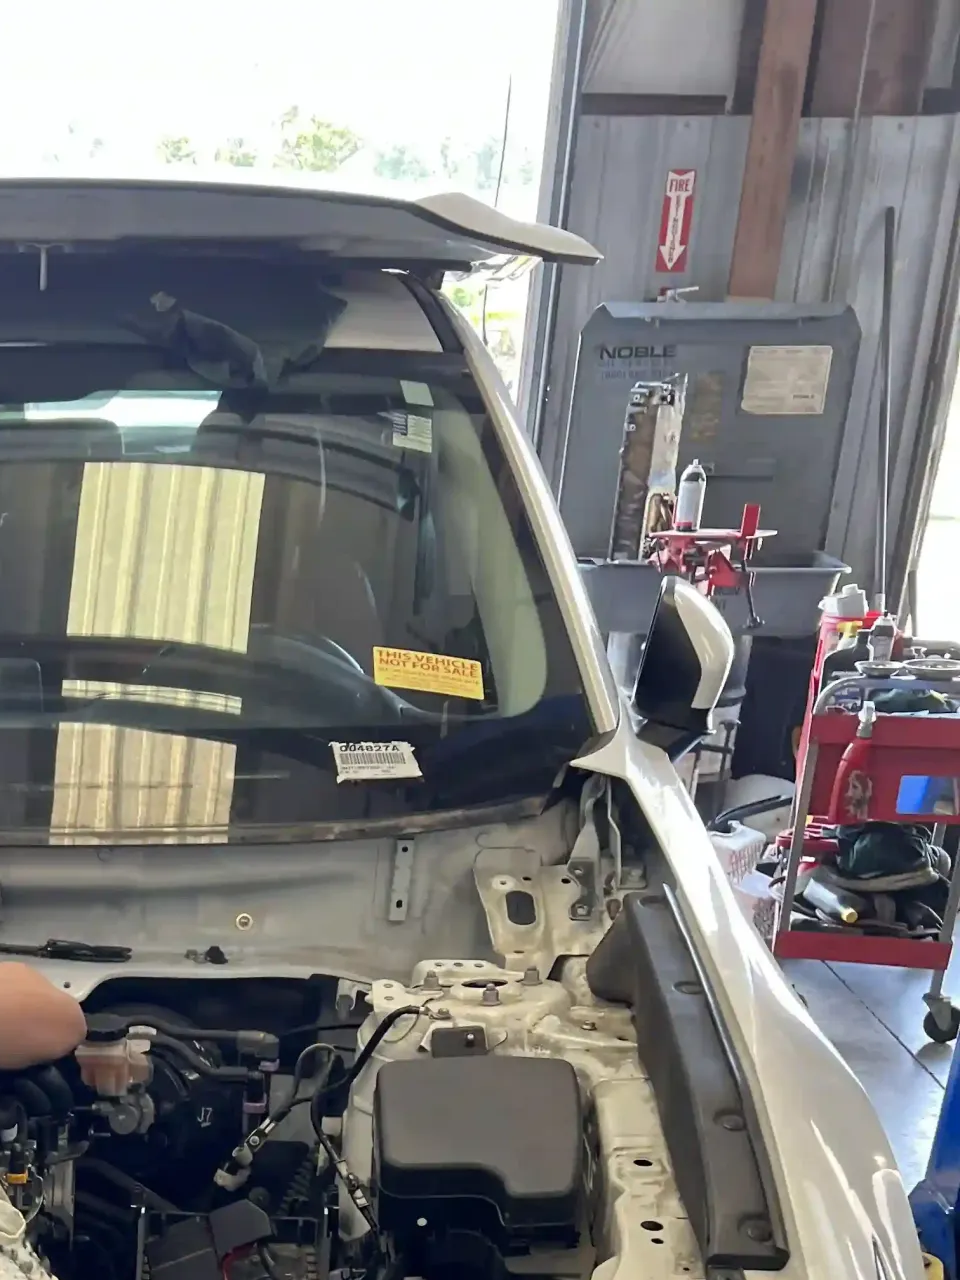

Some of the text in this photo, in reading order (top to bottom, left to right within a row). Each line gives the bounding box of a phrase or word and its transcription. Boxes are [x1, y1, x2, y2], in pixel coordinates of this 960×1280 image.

[669, 179, 690, 192] FIRE
[600, 345, 676, 359] NOBLE
[377, 650, 478, 671] THIS VEHICLE
[379, 658, 408, 667] NOT
[412, 662, 440, 672] FOR
[444, 667, 477, 677] SALE
